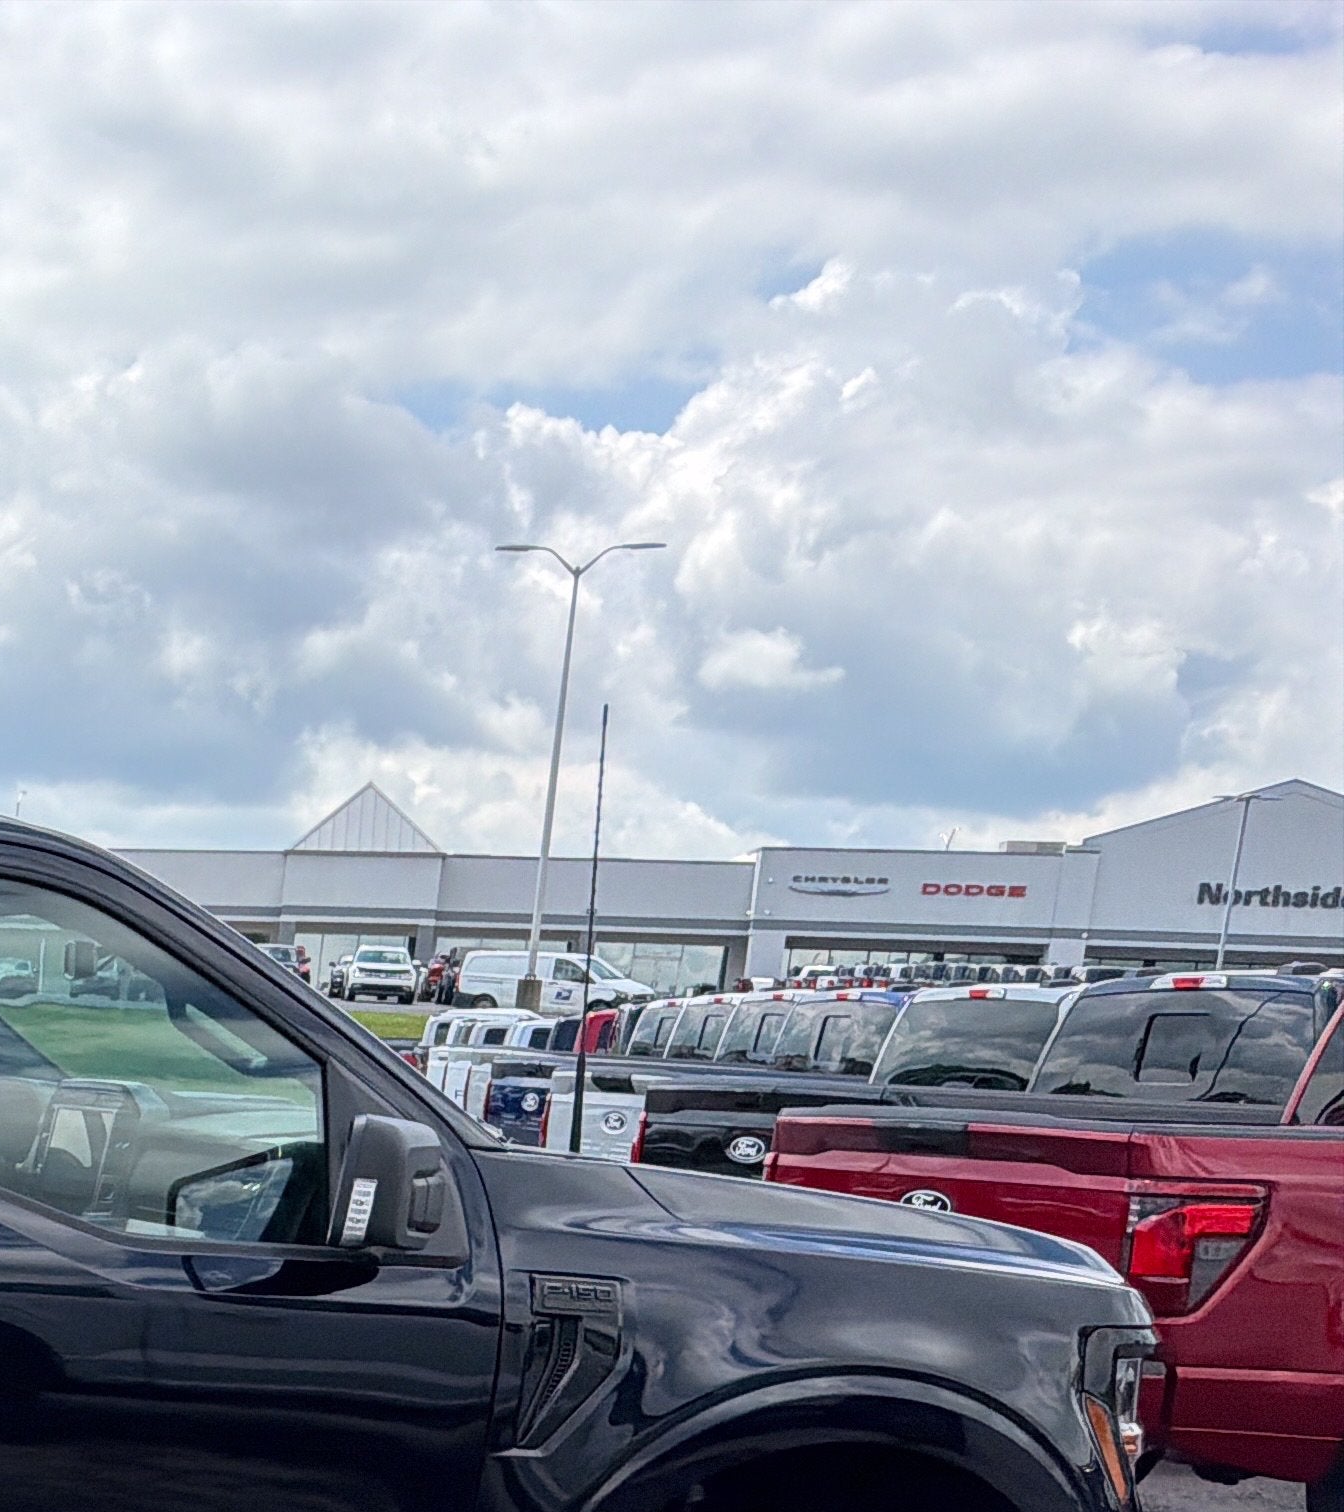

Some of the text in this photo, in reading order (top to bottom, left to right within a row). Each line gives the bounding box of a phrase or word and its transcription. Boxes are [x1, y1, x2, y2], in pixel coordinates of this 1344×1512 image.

[792, 875, 889, 885] CHRYSLER
[921, 882, 1027, 898] DODGE
[1197, 882, 1344, 909] Northsid
[733, 1139, 761, 1157] Ford
